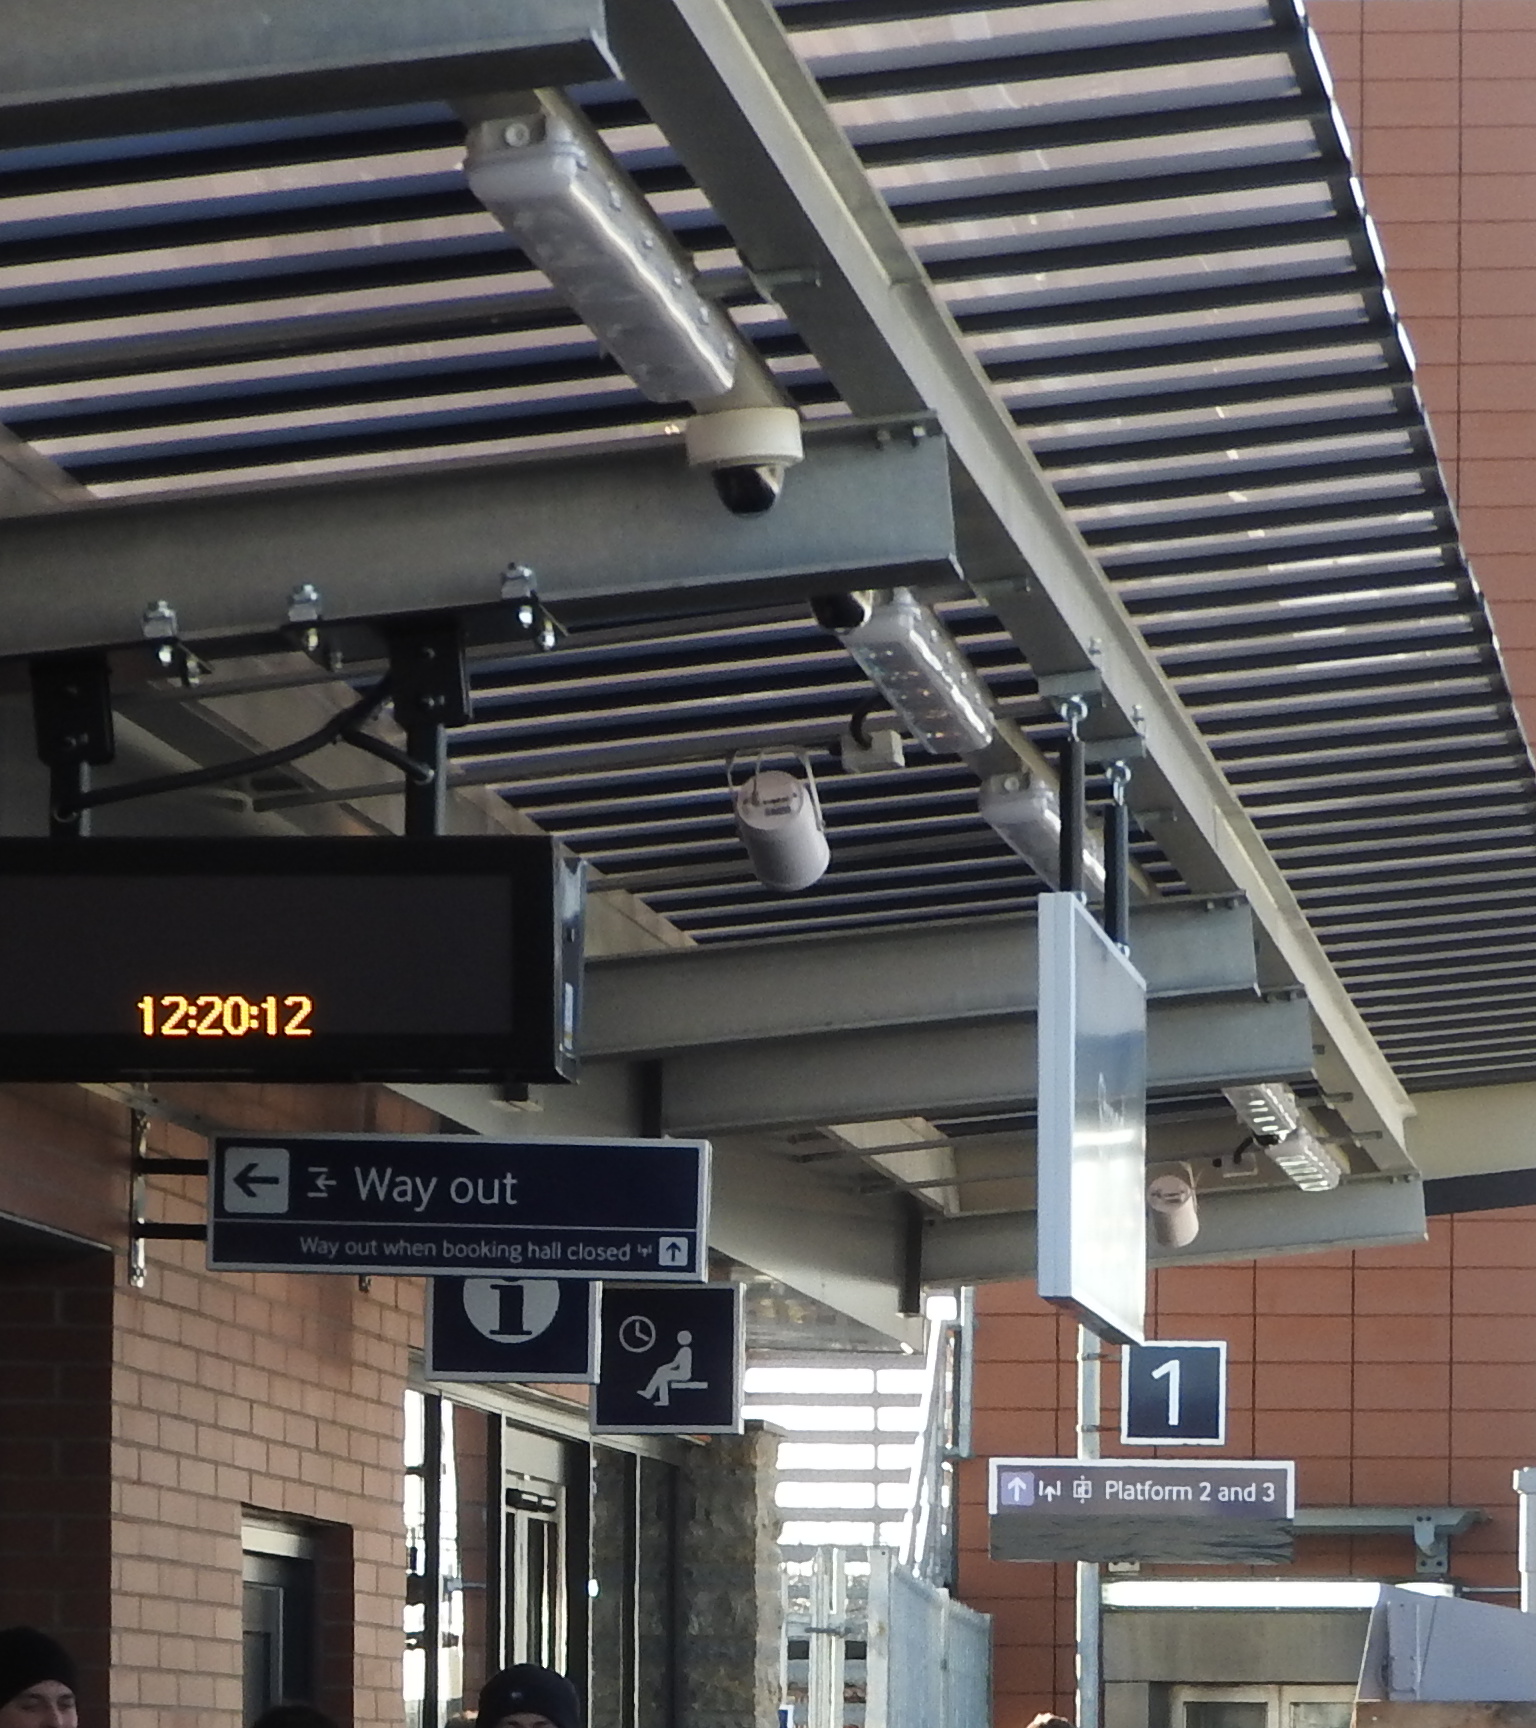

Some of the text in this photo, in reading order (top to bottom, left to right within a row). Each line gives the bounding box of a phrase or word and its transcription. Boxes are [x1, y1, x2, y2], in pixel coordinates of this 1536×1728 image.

[137, 995, 313, 1036] 12:20:12
[355, 1166, 519, 1213] Way out
[300, 1235, 632, 1264] Way out when booking hall closed
[1151, 1359, 1180, 1426] 1
[1105, 1479, 1275, 1503] Platform 2 and 3
